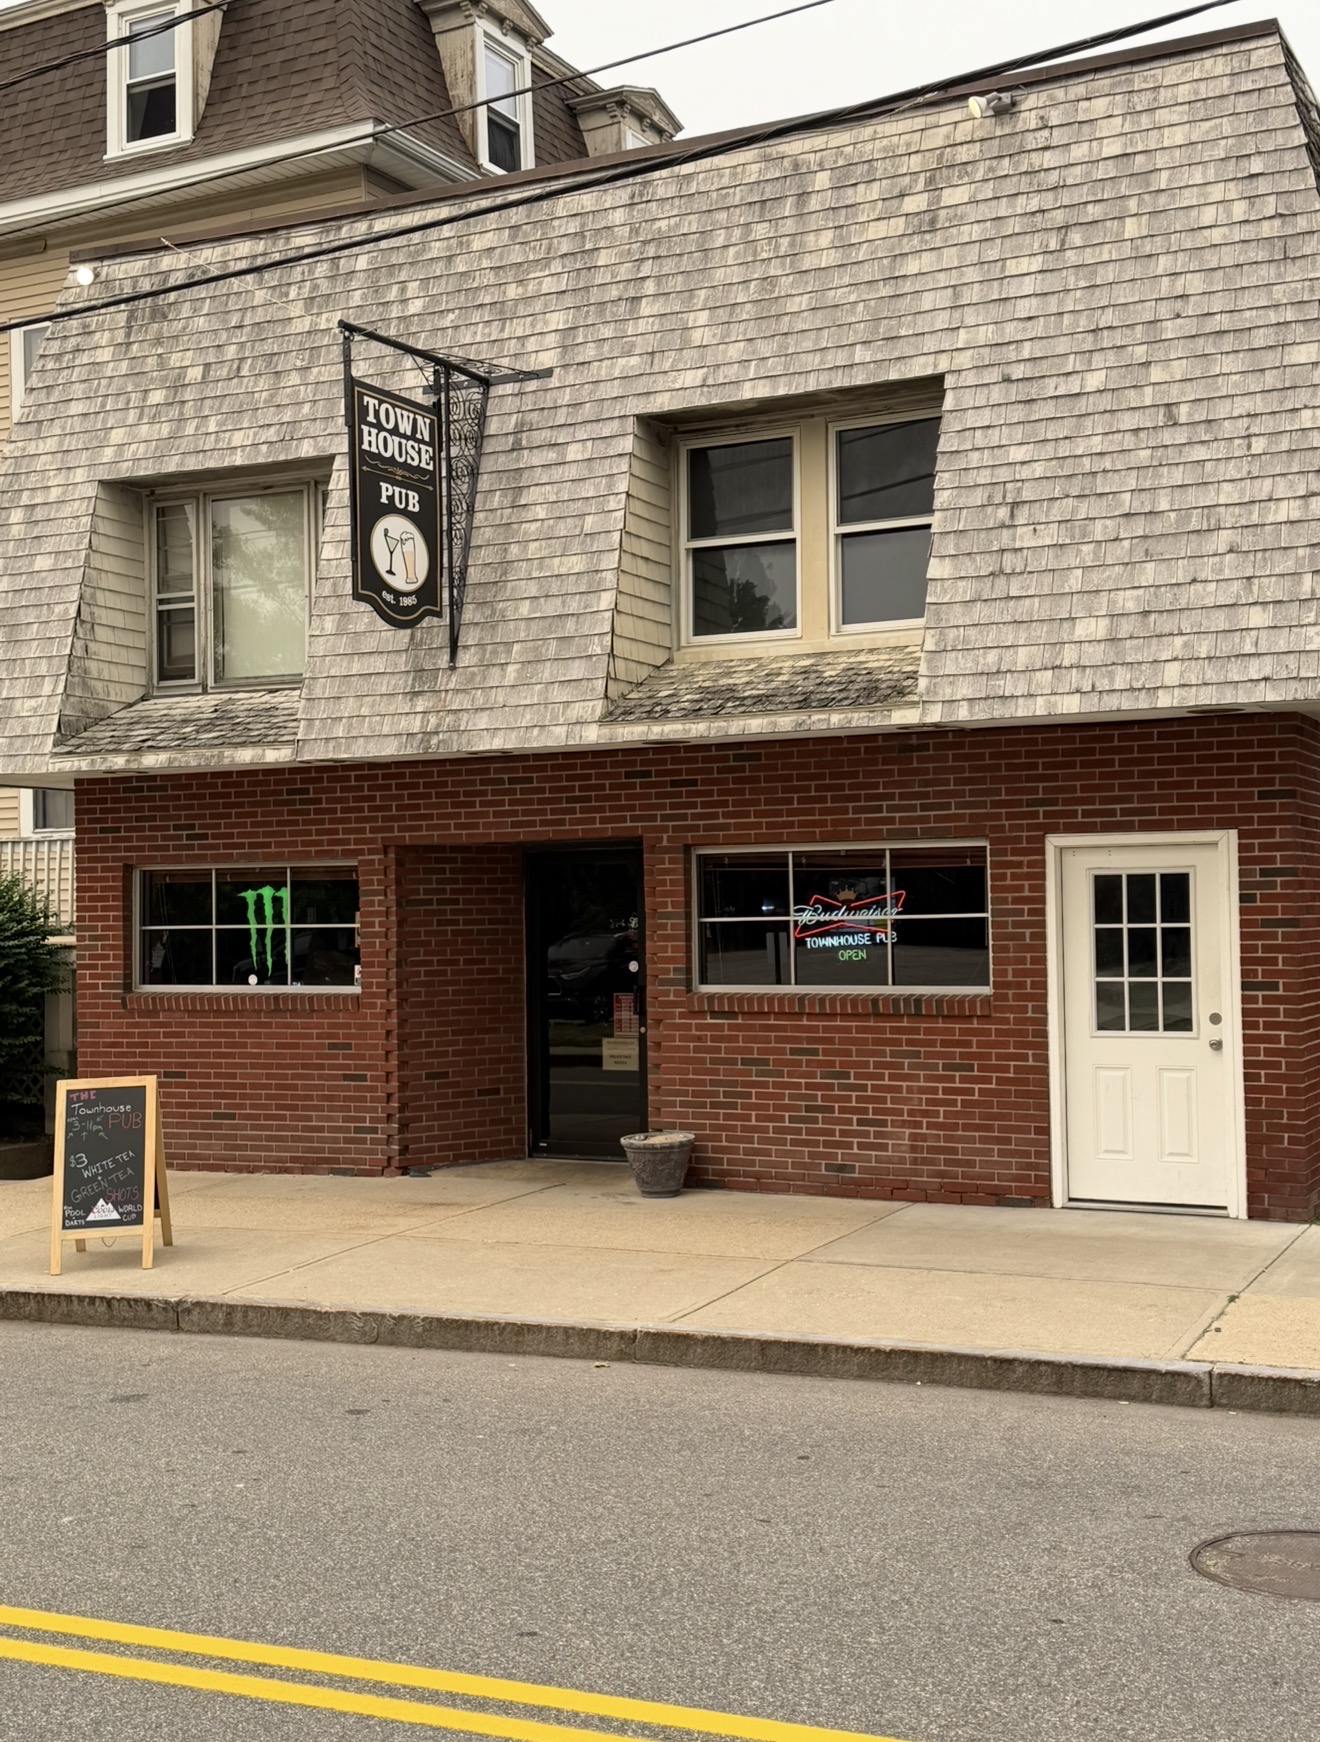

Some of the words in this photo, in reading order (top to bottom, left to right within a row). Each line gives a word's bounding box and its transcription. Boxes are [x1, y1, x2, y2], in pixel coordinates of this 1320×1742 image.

[363, 395, 431, 442] TOWN
[361, 424, 434, 471] HOUSE
[380, 481, 420, 513] PUB
[382, 590, 396, 604] est.
[399, 594, 417, 606] 1985
[805, 933, 871, 949] TOWNHOUSE
[838, 949, 867, 961] OPEN
[69, 1090, 97, 1101] THE
[71, 1101, 132, 1115] Townhouse
[108, 1112, 142, 1129] PUB
[69, 1153, 88, 1168] $3
[81, 1157, 116, 1178] WHITE
[115, 1150, 135, 1163] TEA
[71, 1178, 108, 1203] GREEN
[108, 1167, 135, 1182] TEA
[105, 1185, 140, 1202] SHOTS
[65, 1209, 86, 1217] POOL
[118, 1204, 143, 1213] WORLD
[65, 1219, 85, 1227] DARTS
[122, 1214, 137, 1222] CUP
